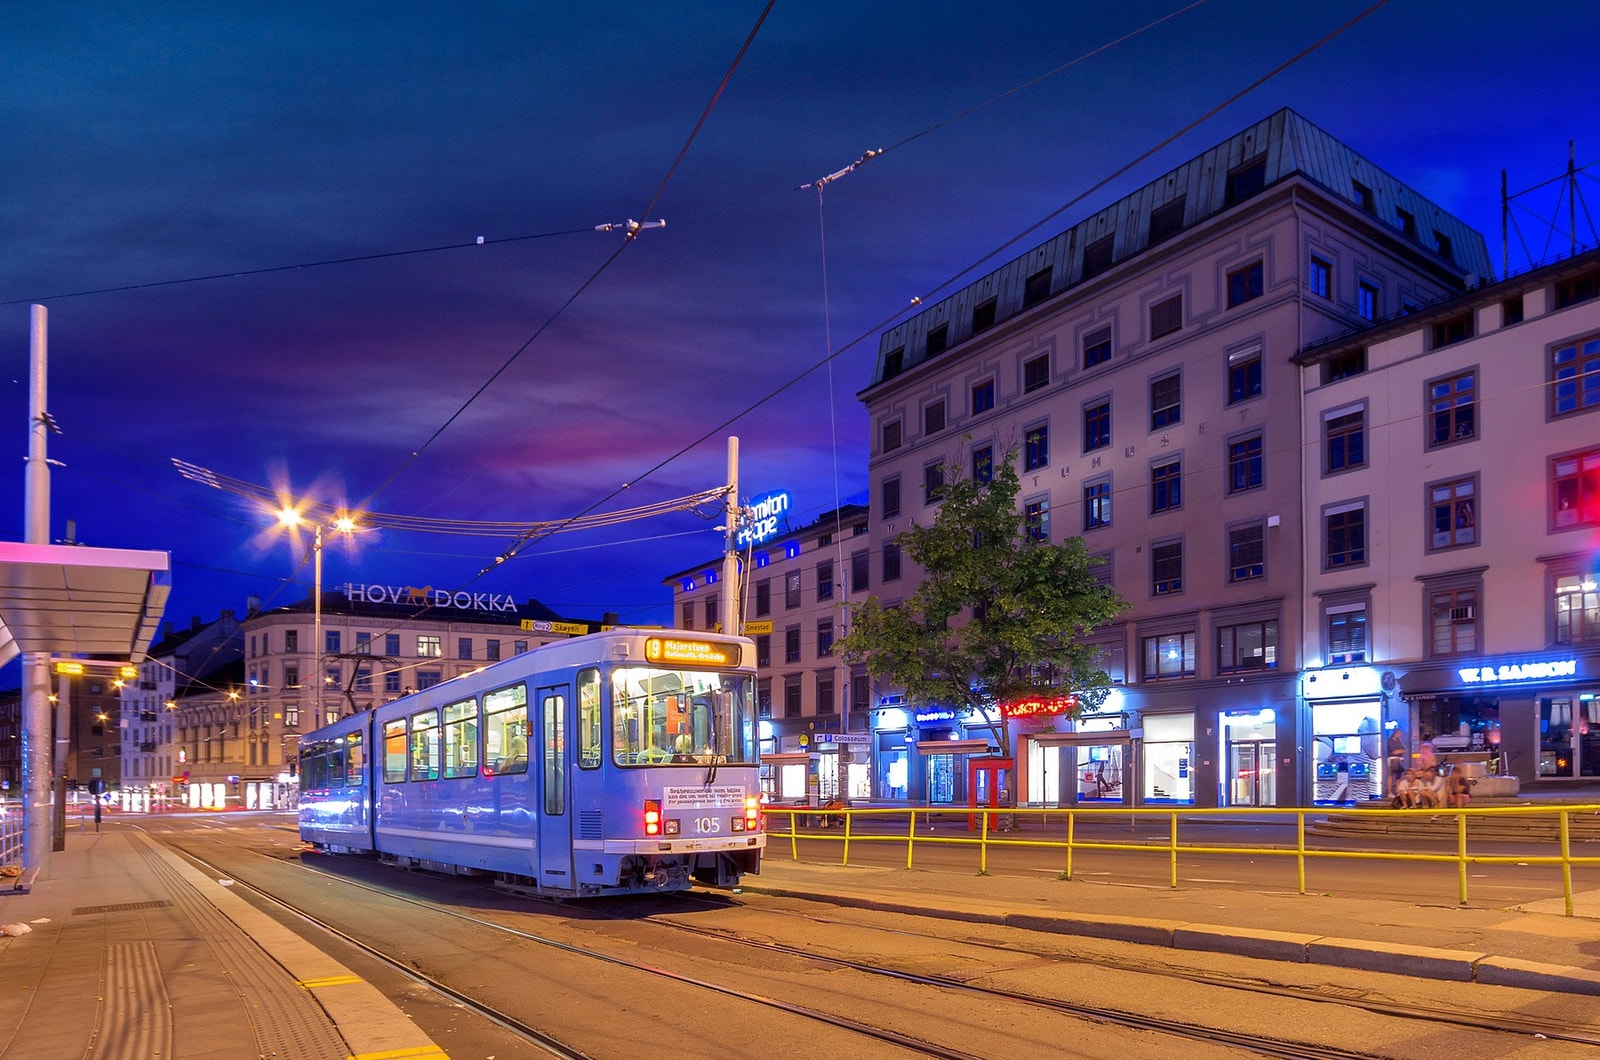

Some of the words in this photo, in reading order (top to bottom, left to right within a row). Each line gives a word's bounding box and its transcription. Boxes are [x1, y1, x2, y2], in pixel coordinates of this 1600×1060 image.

[347, 583, 403, 603] HOV
[435, 589, 518, 613] DOKKA
[746, 624, 769, 632] Smestad
[651, 639, 660, 657] 9
[665, 640, 709, 652] Majorstuen
[694, 817, 720, 833] 105
